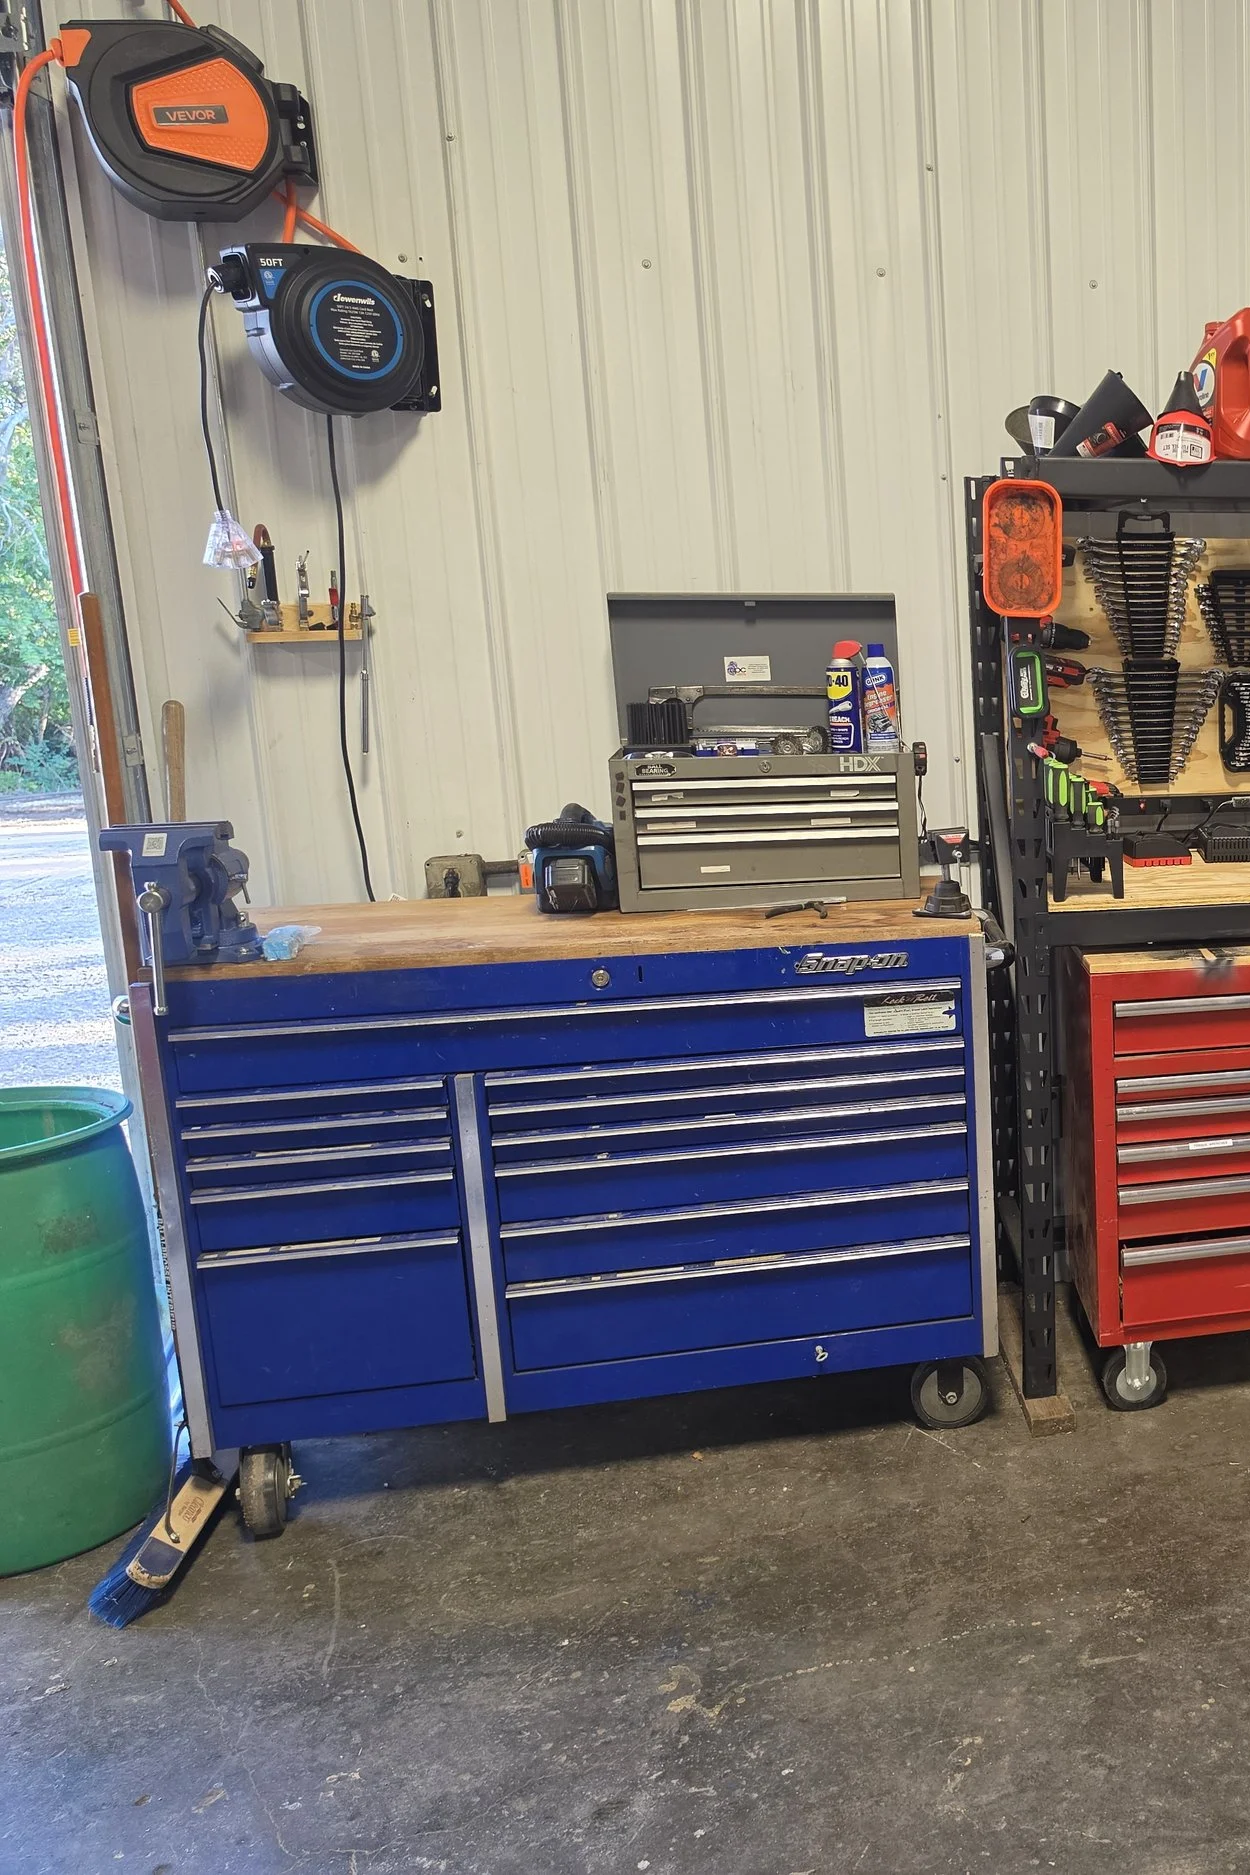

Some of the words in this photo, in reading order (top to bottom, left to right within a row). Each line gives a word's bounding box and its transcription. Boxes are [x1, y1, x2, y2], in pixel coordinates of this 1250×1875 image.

[166, 110, 216, 121] VEVOR
[260, 258, 283, 267] 50FT
[839, 756, 881, 772] HDX
[799, 952, 909, 975] Snap-on
